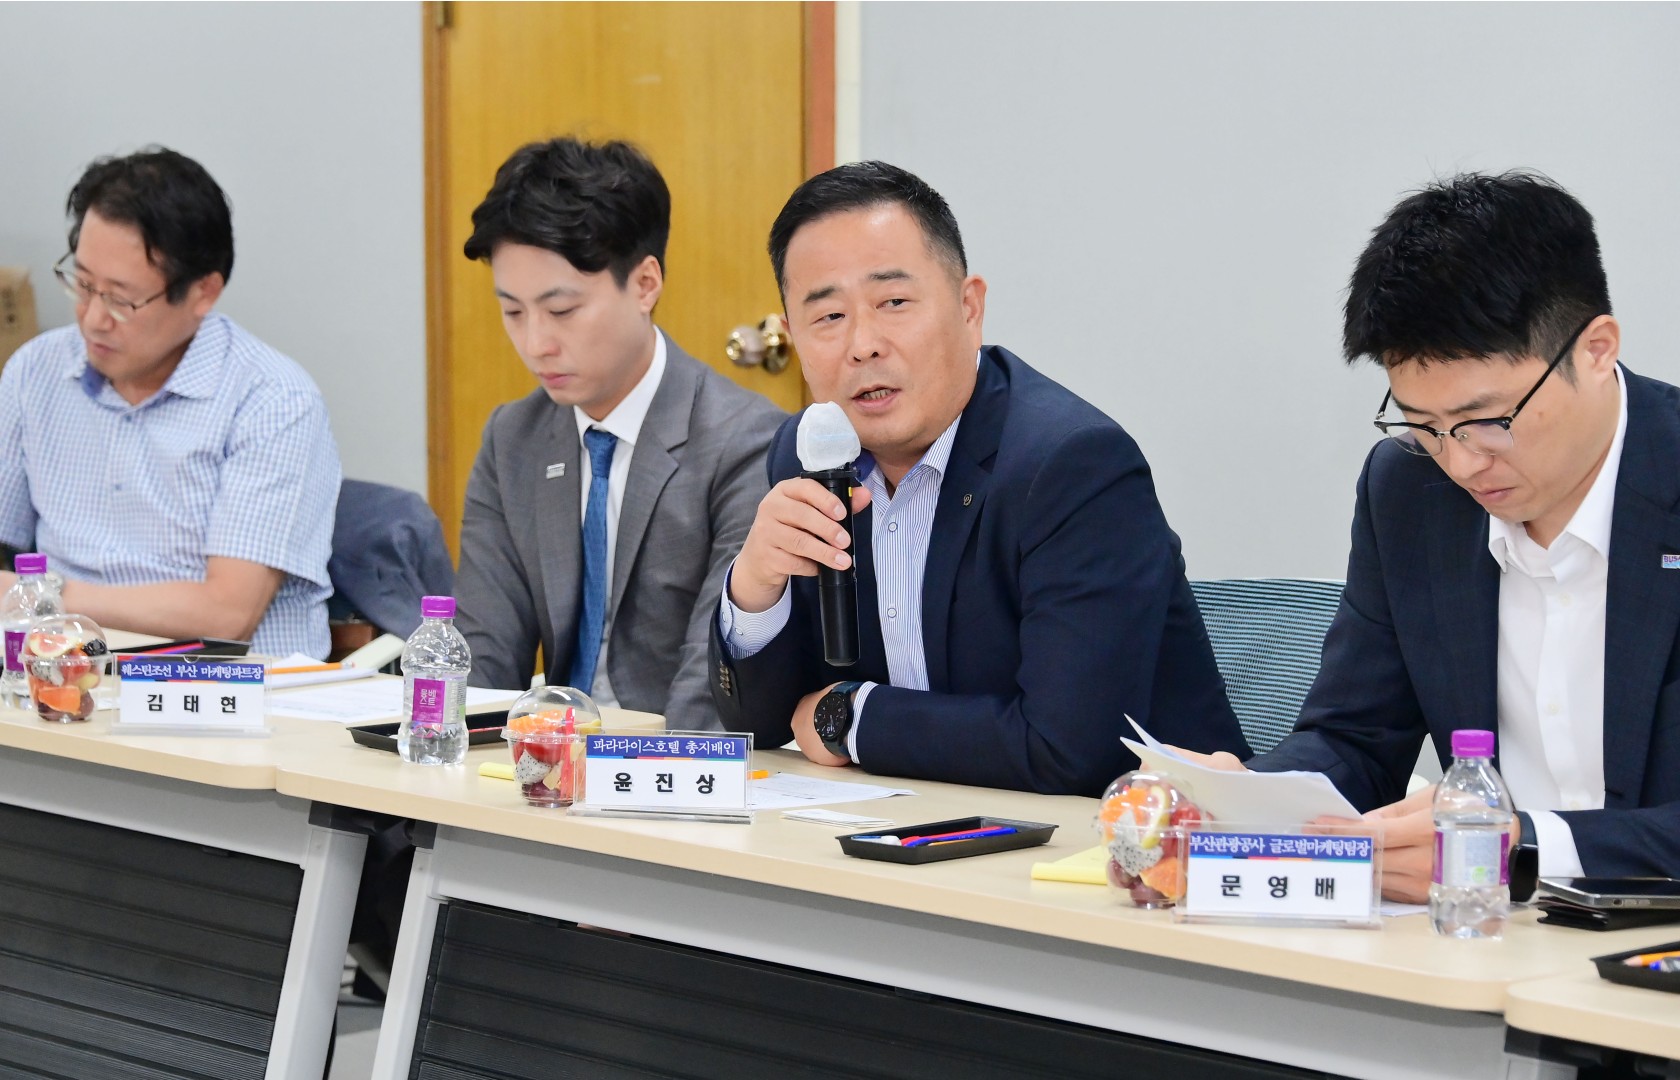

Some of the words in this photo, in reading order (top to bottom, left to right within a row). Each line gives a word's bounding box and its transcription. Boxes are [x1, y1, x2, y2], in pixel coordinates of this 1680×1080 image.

[121, 663, 173, 678] 웨스턴조선
[176, 664, 198, 678] 부산
[201, 665, 263, 680] 마케팅파트장
[593, 738, 680, 754] 파라다이스호텔
[685, 740, 736, 756] 총지배인
[1190, 835, 1265, 854] 부산관광공사
[1269, 837, 1370, 857] 글로벌마케팅팀장
